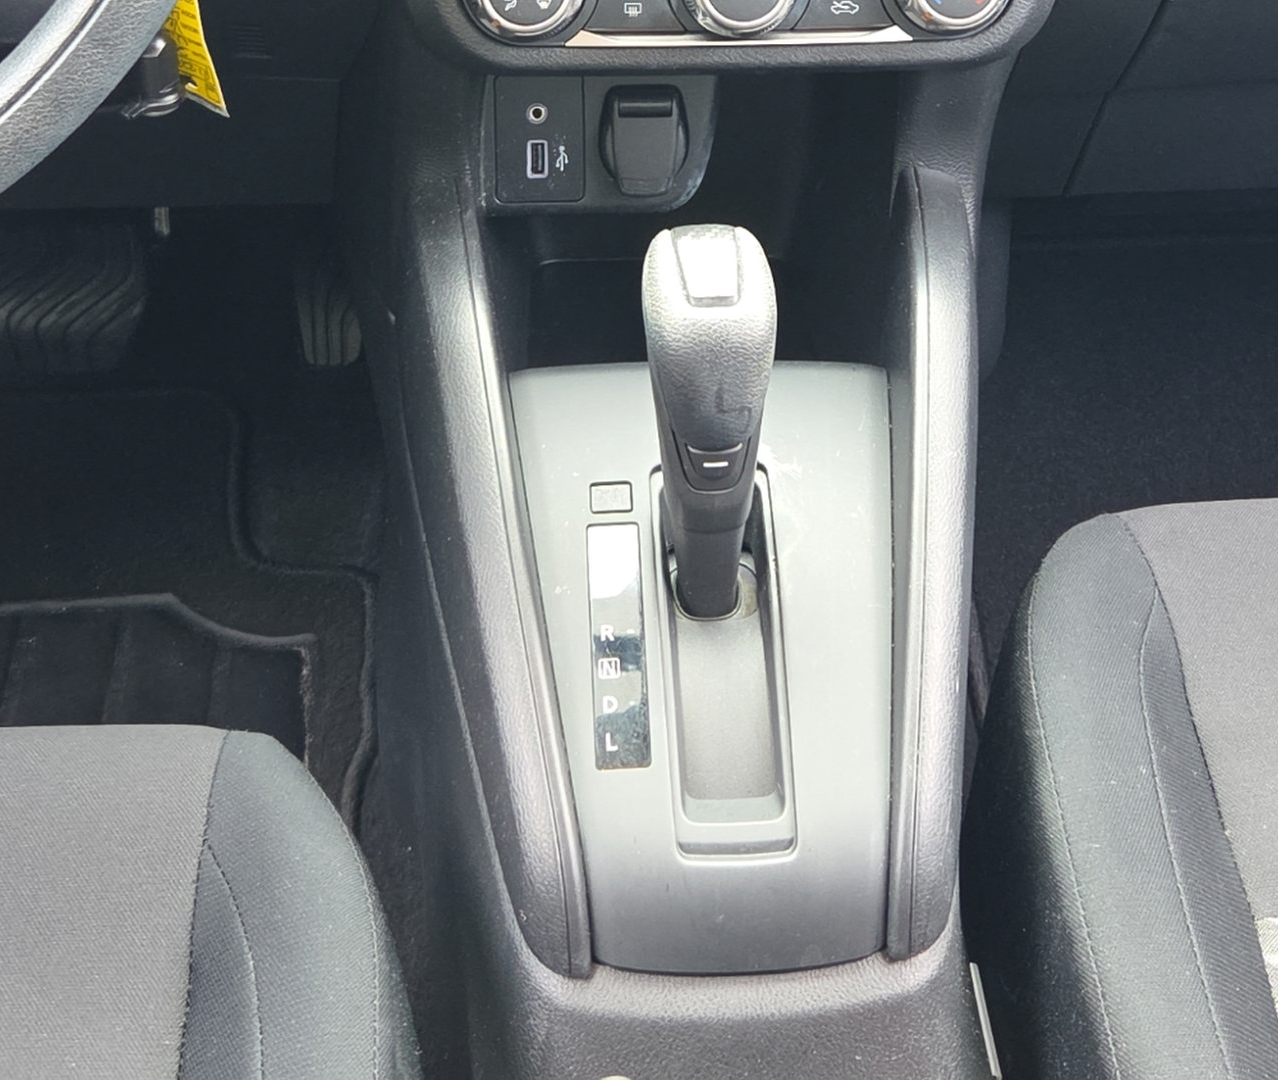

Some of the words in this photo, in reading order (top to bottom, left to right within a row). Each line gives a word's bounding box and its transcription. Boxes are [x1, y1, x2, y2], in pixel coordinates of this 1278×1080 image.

[600, 624, 615, 641] R
[602, 661, 617, 677] N
[602, 696, 618, 713] D
[605, 732, 618, 752] L
